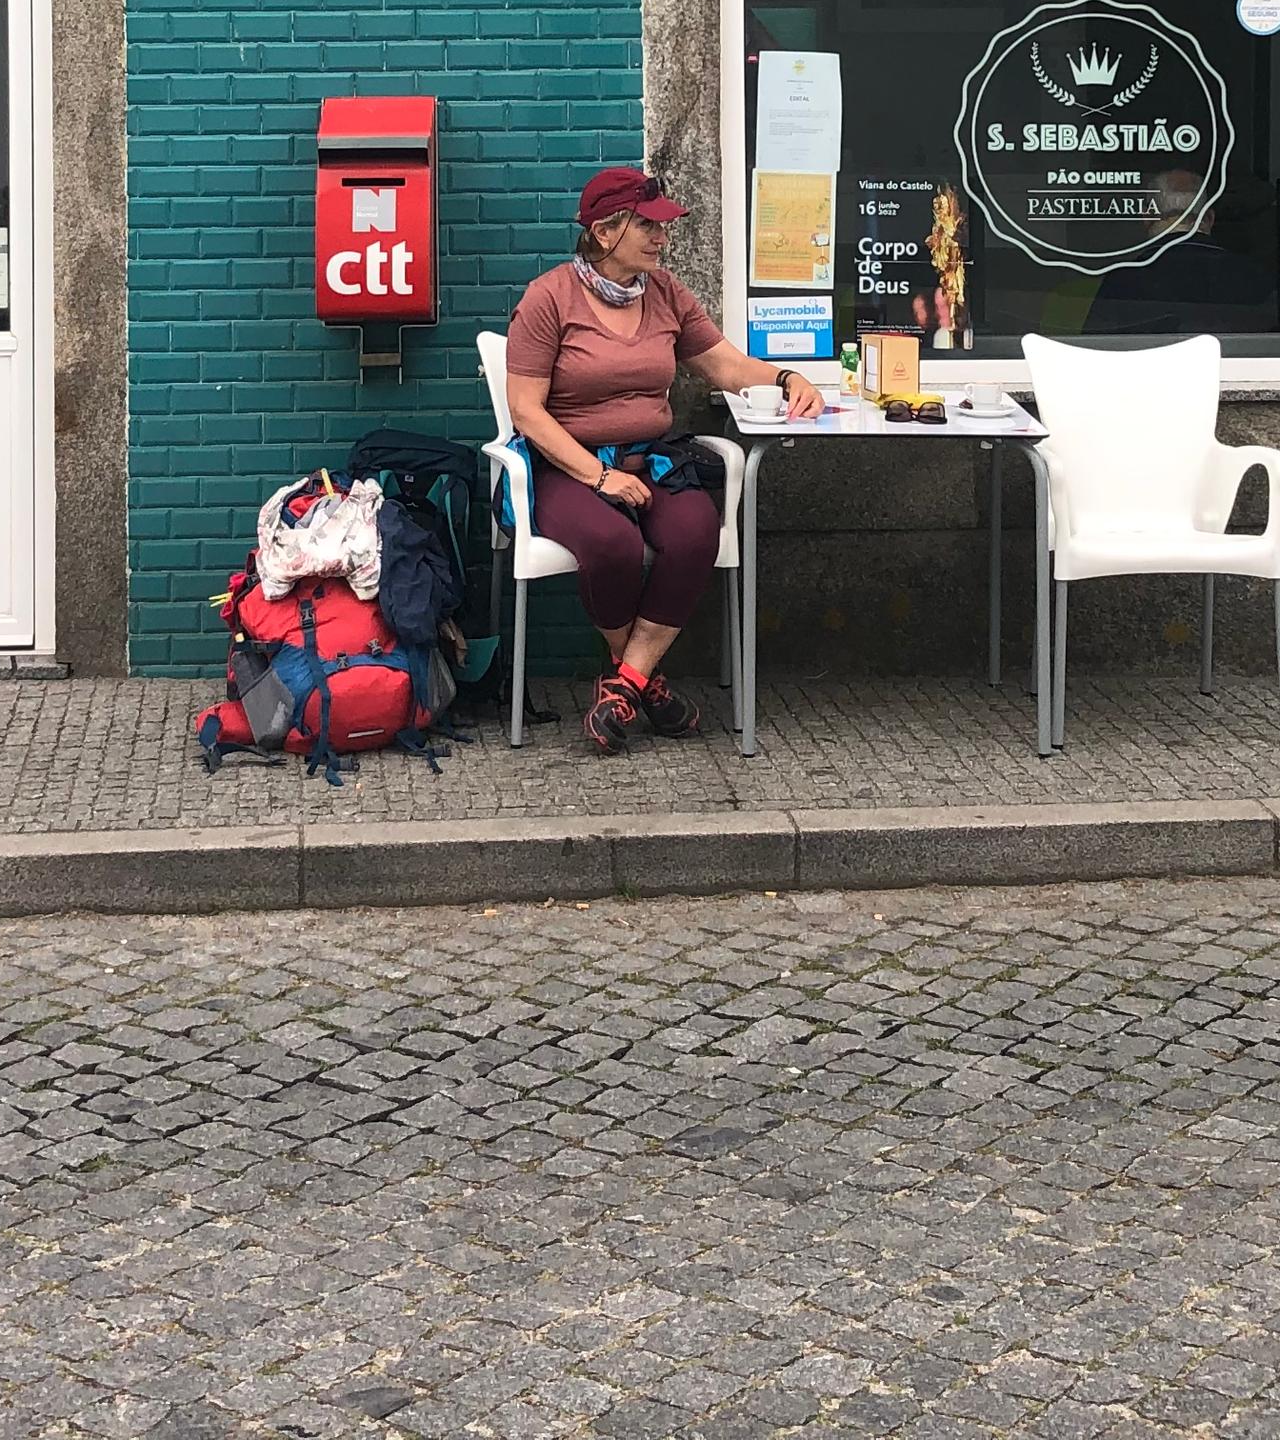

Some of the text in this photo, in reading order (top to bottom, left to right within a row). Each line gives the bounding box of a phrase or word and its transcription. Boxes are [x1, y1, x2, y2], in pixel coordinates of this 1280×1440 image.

[987, 118, 1201, 152] S. SEBASTIÃO
[859, 180, 933, 191] Viana do Castelo
[1047, 168, 1141, 185] PÃO QUENTE
[858, 200, 901, 216] 16 junho
[1027, 197, 1161, 215] PASTELARIA
[858, 237, 918, 260] Corpo
[326, 240, 413, 295] ctt
[858, 256, 882, 274] de
[858, 276, 910, 295] Deus
[754, 304, 827, 318] Lycamobile
[806, 320, 829, 332] Aqui
